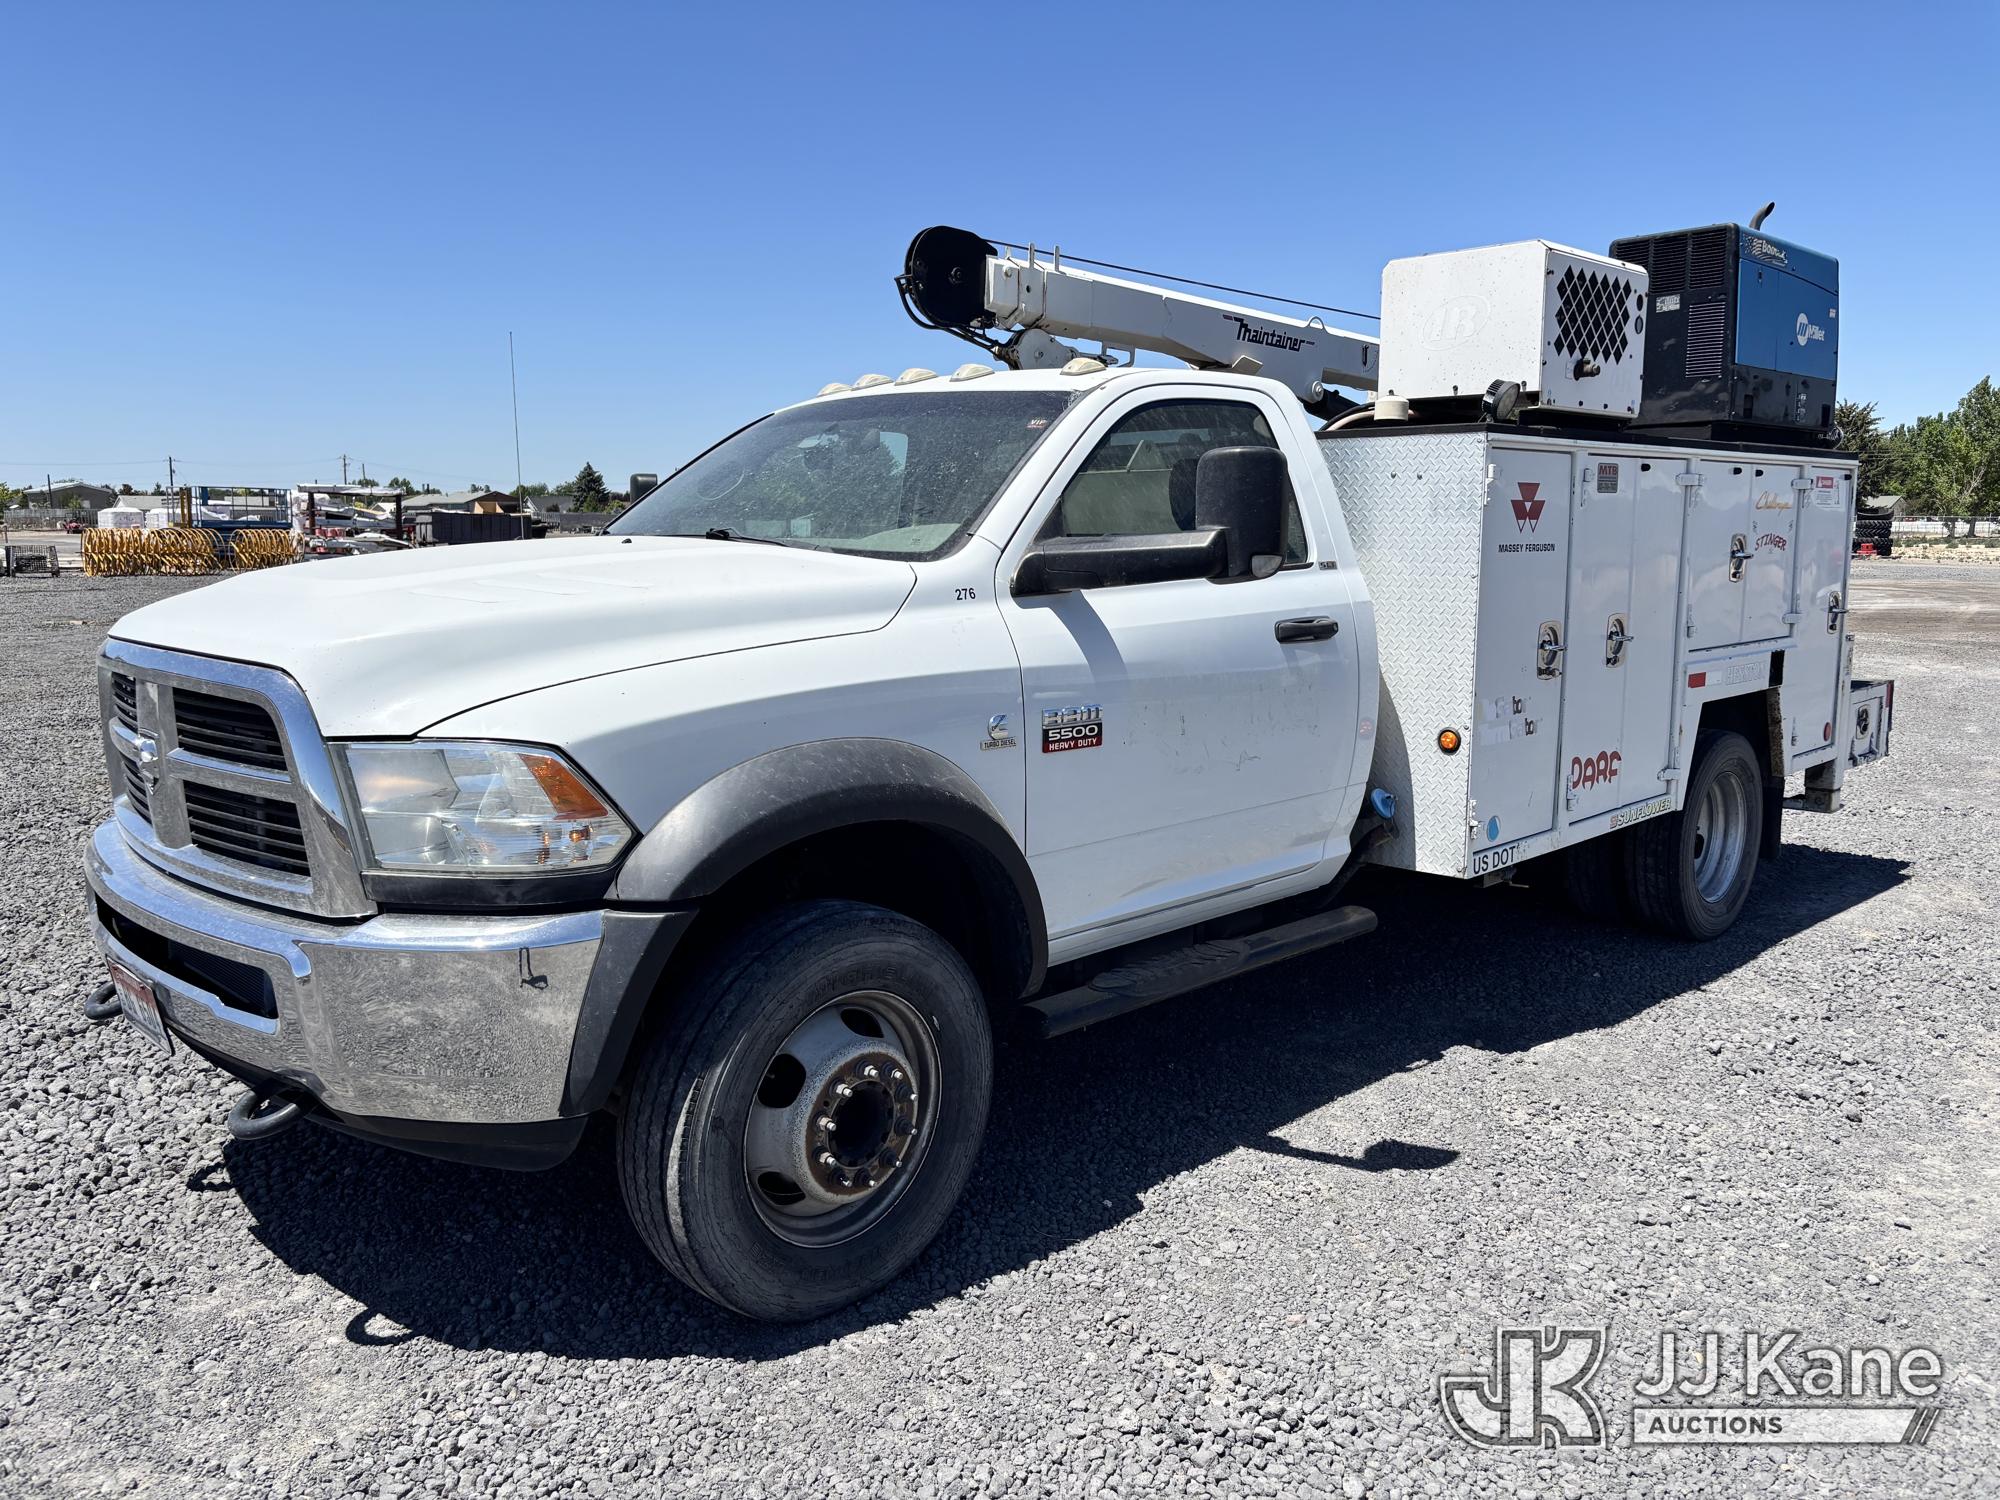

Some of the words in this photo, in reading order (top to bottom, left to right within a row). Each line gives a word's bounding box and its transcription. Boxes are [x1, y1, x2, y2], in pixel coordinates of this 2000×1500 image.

[1232, 316, 1306, 352] Maintainer
[1600, 465, 1618, 476] MTB
[1498, 544, 1523, 553] MASSEY
[1525, 543, 1556, 552] FERGUSON
[1755, 532, 1787, 551] STINGER
[954, 587, 976, 601] 276
[1048, 725, 1099, 741] 5500
[1049, 740, 1075, 751] HEAVY
[1078, 737, 1097, 748] DUTY
[1617, 799, 1671, 827] SUNFLOWER
[1473, 855, 1489, 875] US
[1492, 845, 1516, 868] DOT
